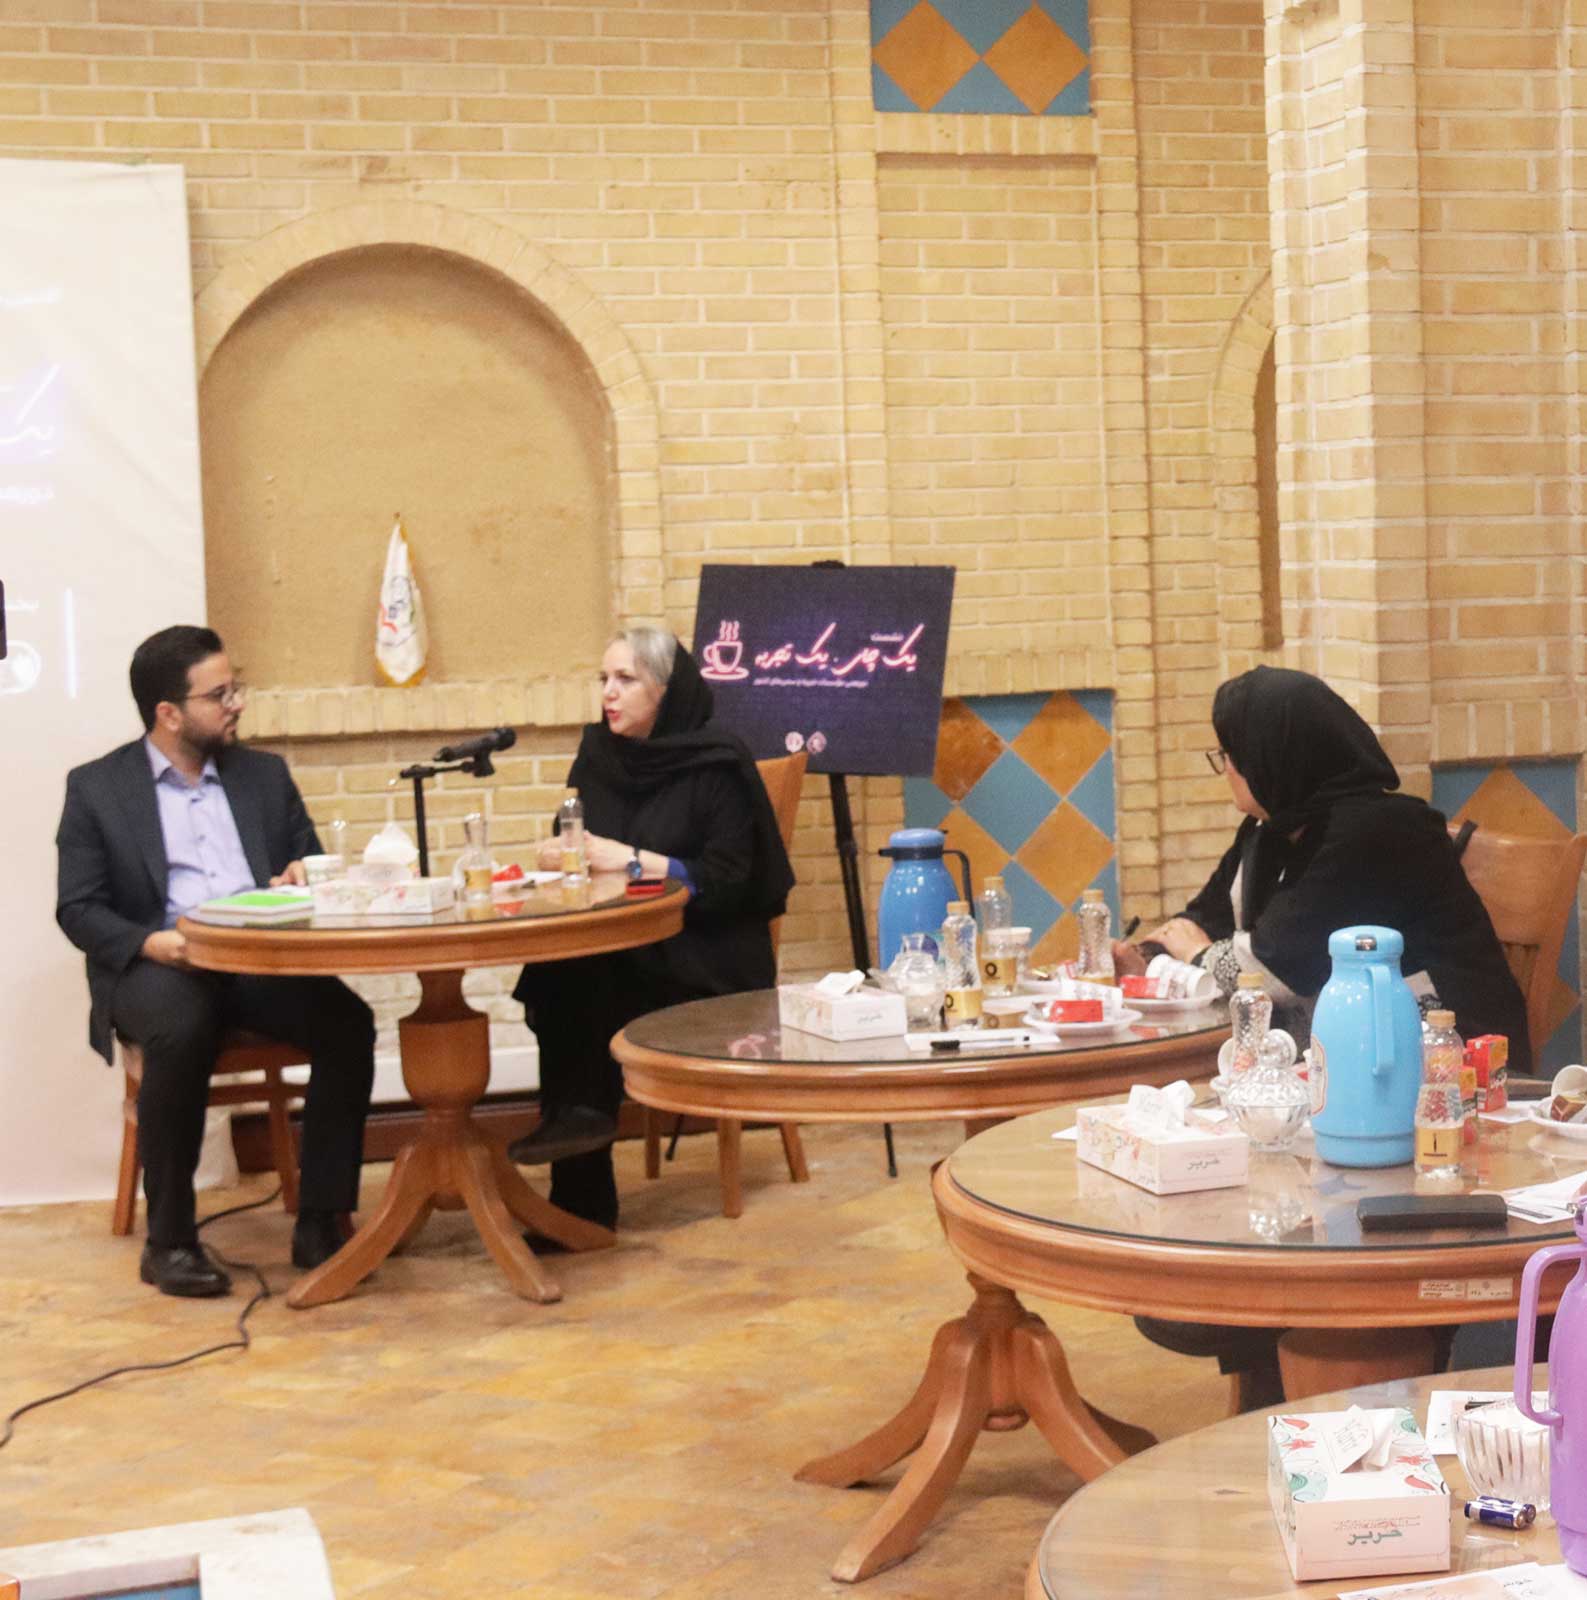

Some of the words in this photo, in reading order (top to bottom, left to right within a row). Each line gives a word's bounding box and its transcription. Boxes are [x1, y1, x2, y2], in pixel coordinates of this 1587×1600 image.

[755, 643, 794, 669] تجربه
[795, 622, 837, 670] یک
[881, 623, 924, 672] یک
[1347, 1529, 1403, 1546] حریر
